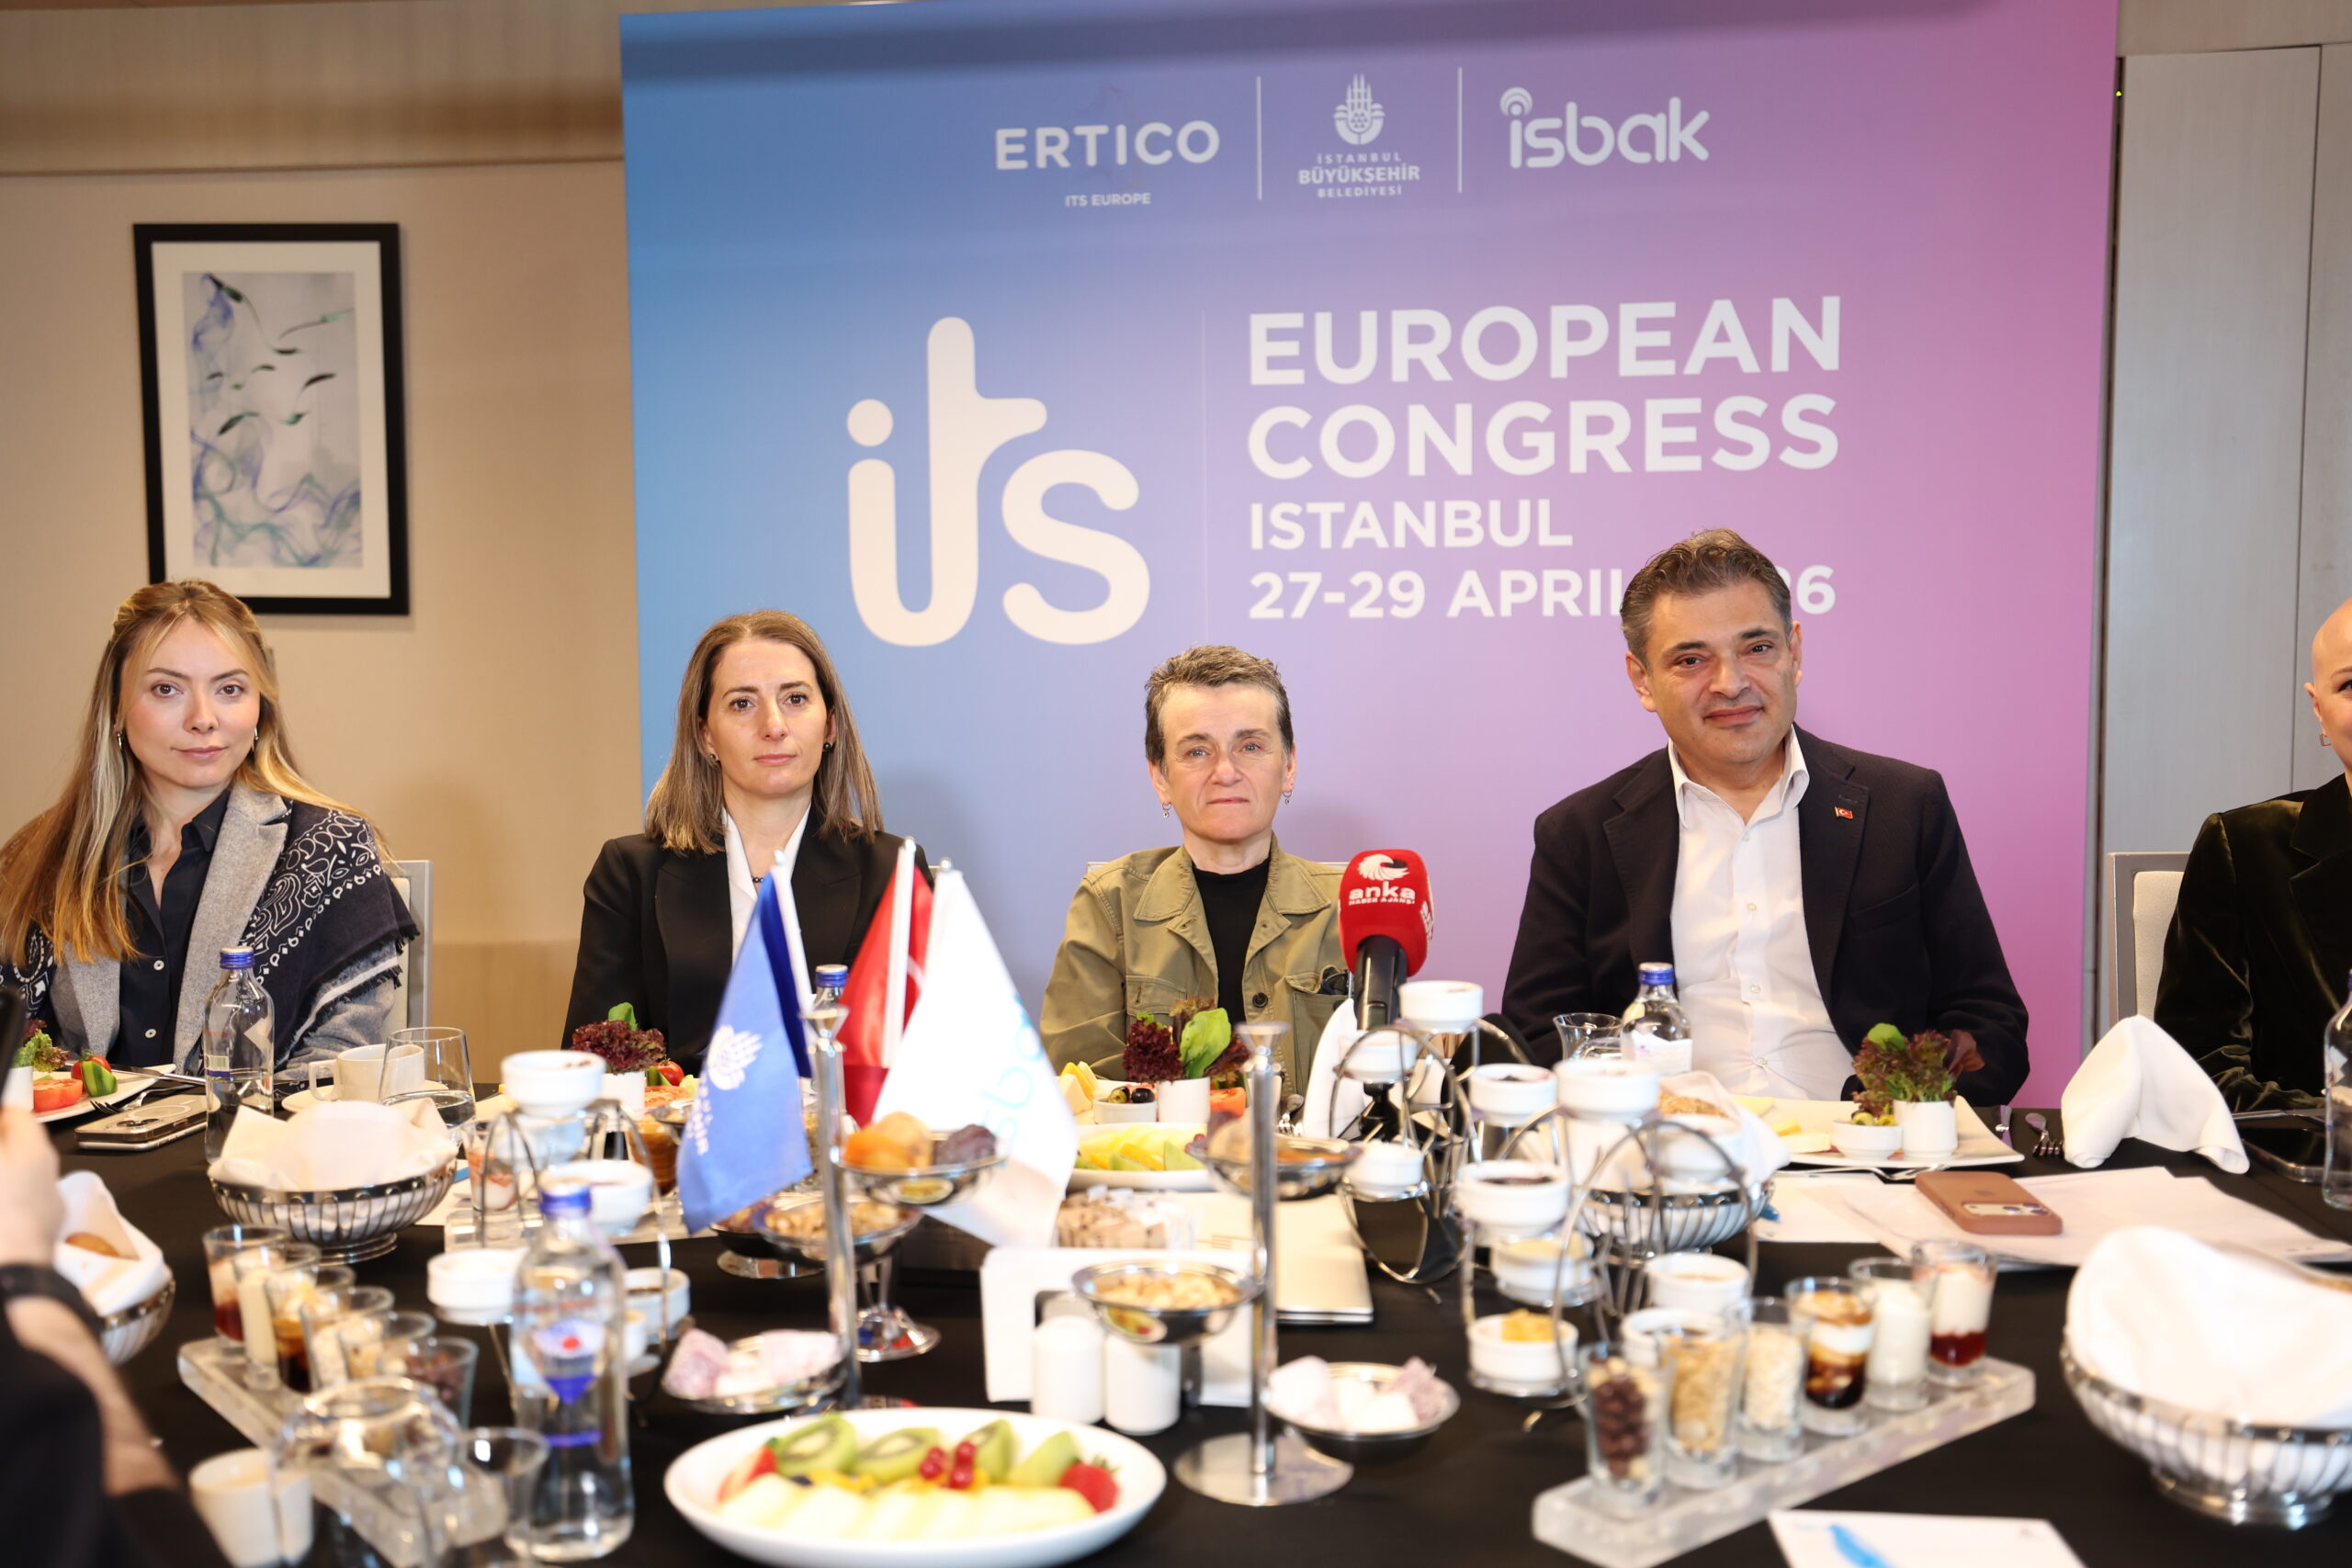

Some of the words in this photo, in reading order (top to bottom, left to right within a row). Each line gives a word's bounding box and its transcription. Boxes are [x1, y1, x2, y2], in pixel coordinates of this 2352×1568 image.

[996, 120, 1220, 170] ERTICO
[1500, 87, 1710, 169] isbak
[1298, 164, 1420, 184] BÜYÜKŞEHİR
[1317, 184, 1402, 198] BELEDİYESİ
[1065, 193, 1088, 207] ITS
[1091, 192, 1151, 207] EUROPE
[1250, 296, 1840, 386] EUROPEAN
[1248, 394, 1839, 479] CONGRESS
[847, 318, 1151, 647] its
[1250, 499, 1573, 550] ISTANBUL
[1250, 570, 1426, 619] 27-29
[1349, 881, 1416, 900] anka
